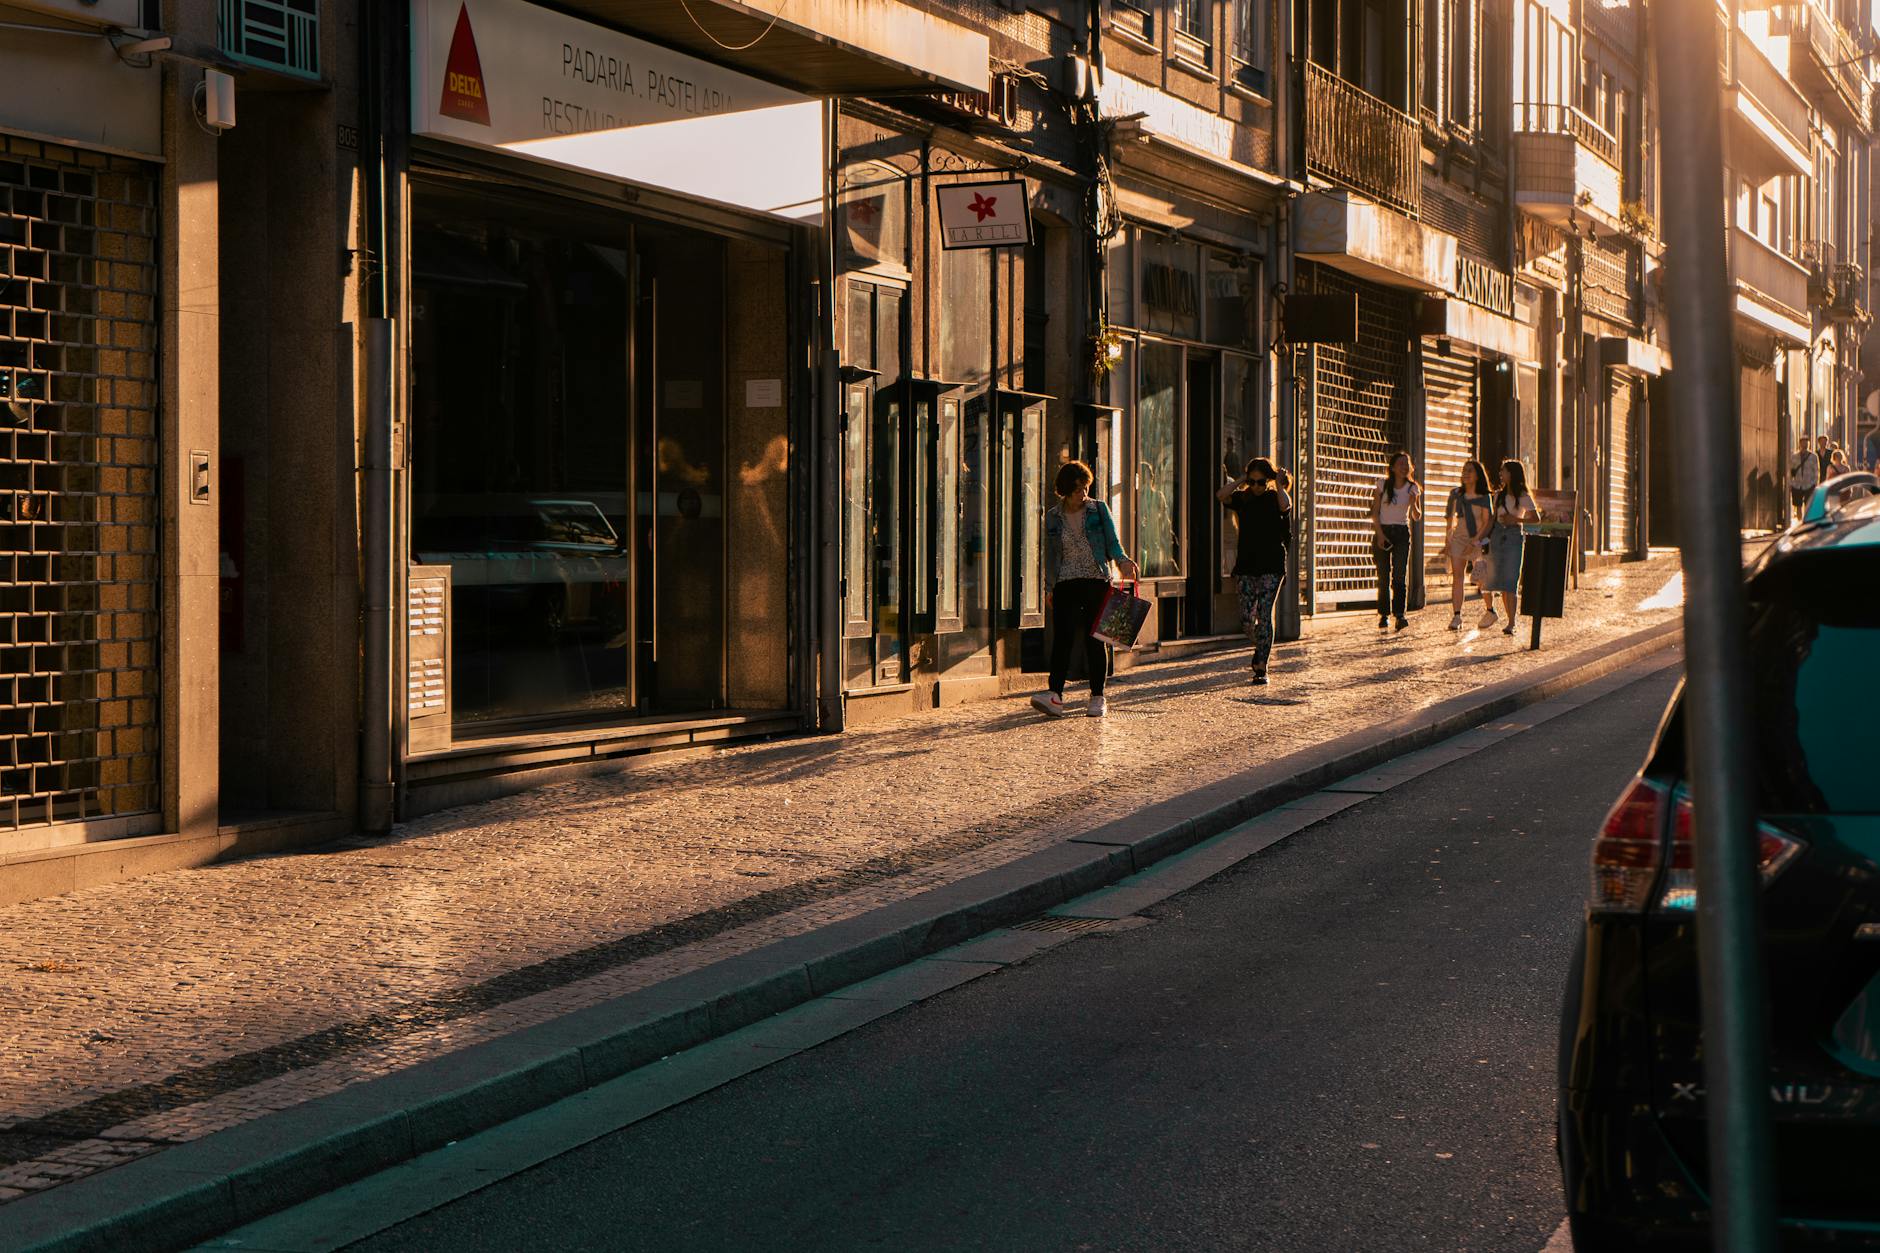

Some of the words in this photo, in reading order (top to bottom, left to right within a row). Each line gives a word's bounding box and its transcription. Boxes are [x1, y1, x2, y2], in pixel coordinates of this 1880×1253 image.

[449, 71, 482, 98] DELTA
[563, 43, 634, 96] PADARIA
[648, 70, 732, 114] PASTELARIA
[543, 96, 632, 135] RESTAU
[338, 125, 358, 148] 805
